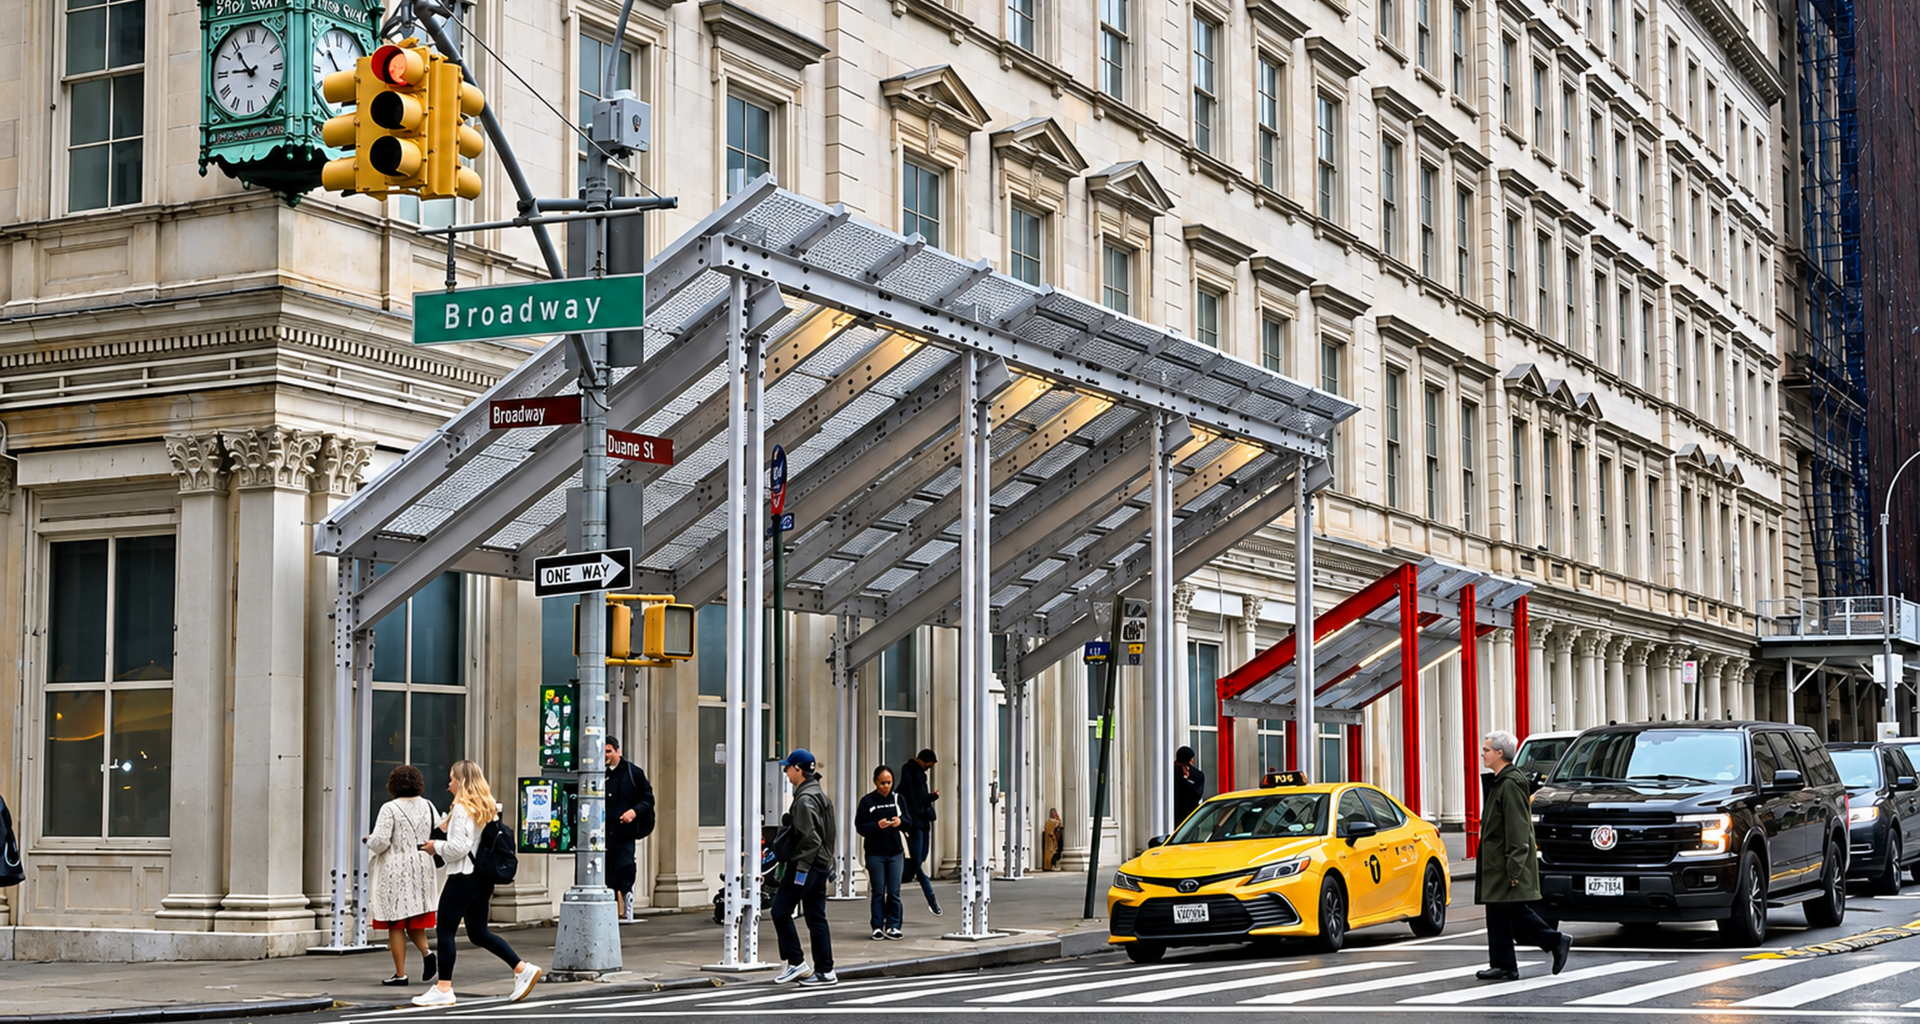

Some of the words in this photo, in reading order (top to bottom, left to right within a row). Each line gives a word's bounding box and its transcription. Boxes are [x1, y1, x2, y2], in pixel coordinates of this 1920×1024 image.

[445, 296, 601, 329] Broadway
[493, 405, 546, 426] Broadway
[608, 435, 640, 457] Duane
[643, 441, 655, 460] St
[546, 568, 571, 584] ONE
[582, 563, 610, 580] WAY
